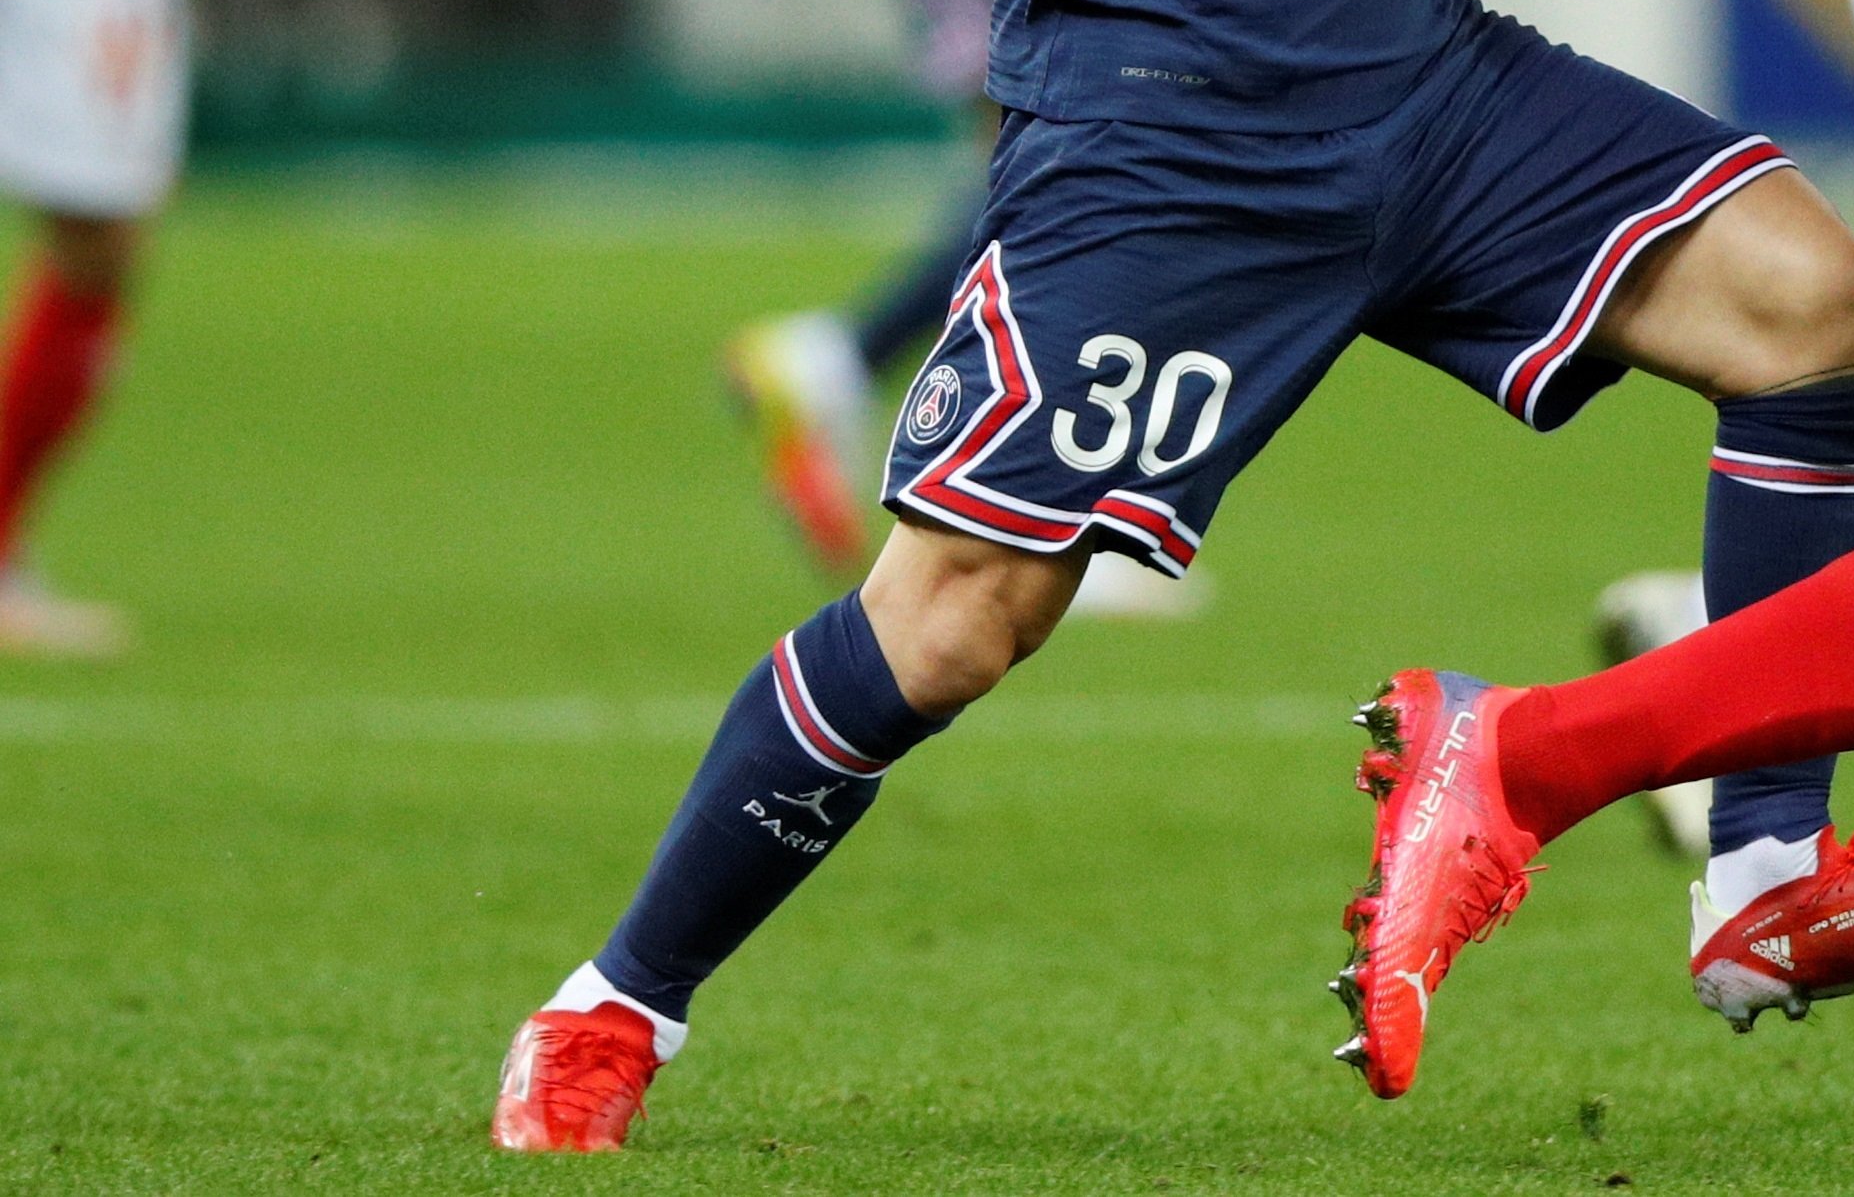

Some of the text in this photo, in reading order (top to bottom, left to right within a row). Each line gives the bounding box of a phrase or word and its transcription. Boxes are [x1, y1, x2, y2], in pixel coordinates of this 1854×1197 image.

[929, 369, 958, 394] PARIS
[1050, 333, 1234, 477] 30
[1405, 710, 1477, 843] ULTRA
[742, 799, 829, 853] PARIS
[1749, 941, 1796, 972] adidas
